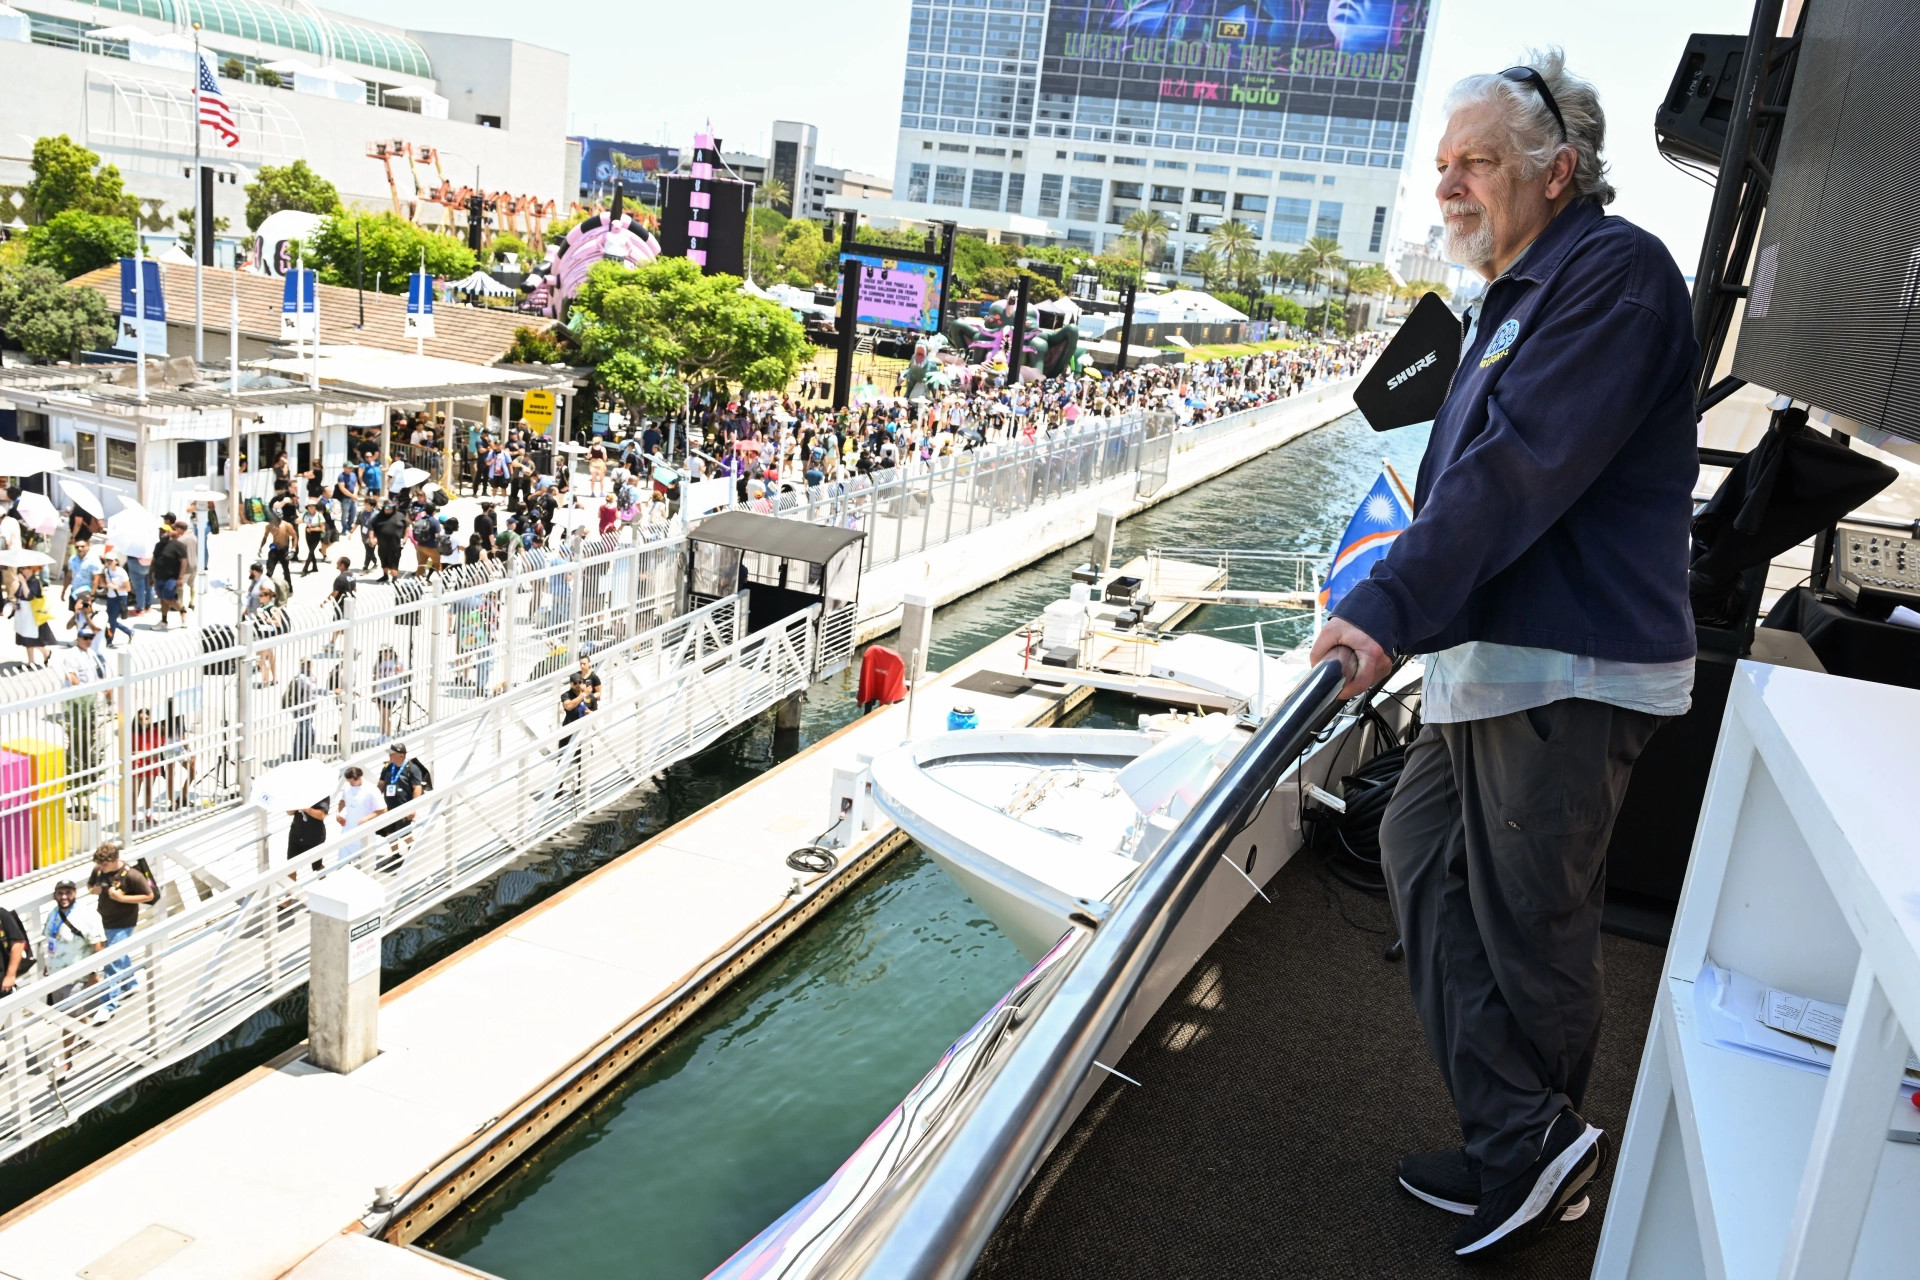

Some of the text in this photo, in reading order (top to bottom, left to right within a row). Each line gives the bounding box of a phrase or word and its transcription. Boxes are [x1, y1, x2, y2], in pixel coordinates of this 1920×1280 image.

[1223, 25, 1241, 36] FX
[1064, 32, 1407, 81] WHAT WE DO IN THE SHADOWS
[1160, 78, 1280, 105] 10.21 FX hulu
[1386, 350, 1437, 391] SHURE
